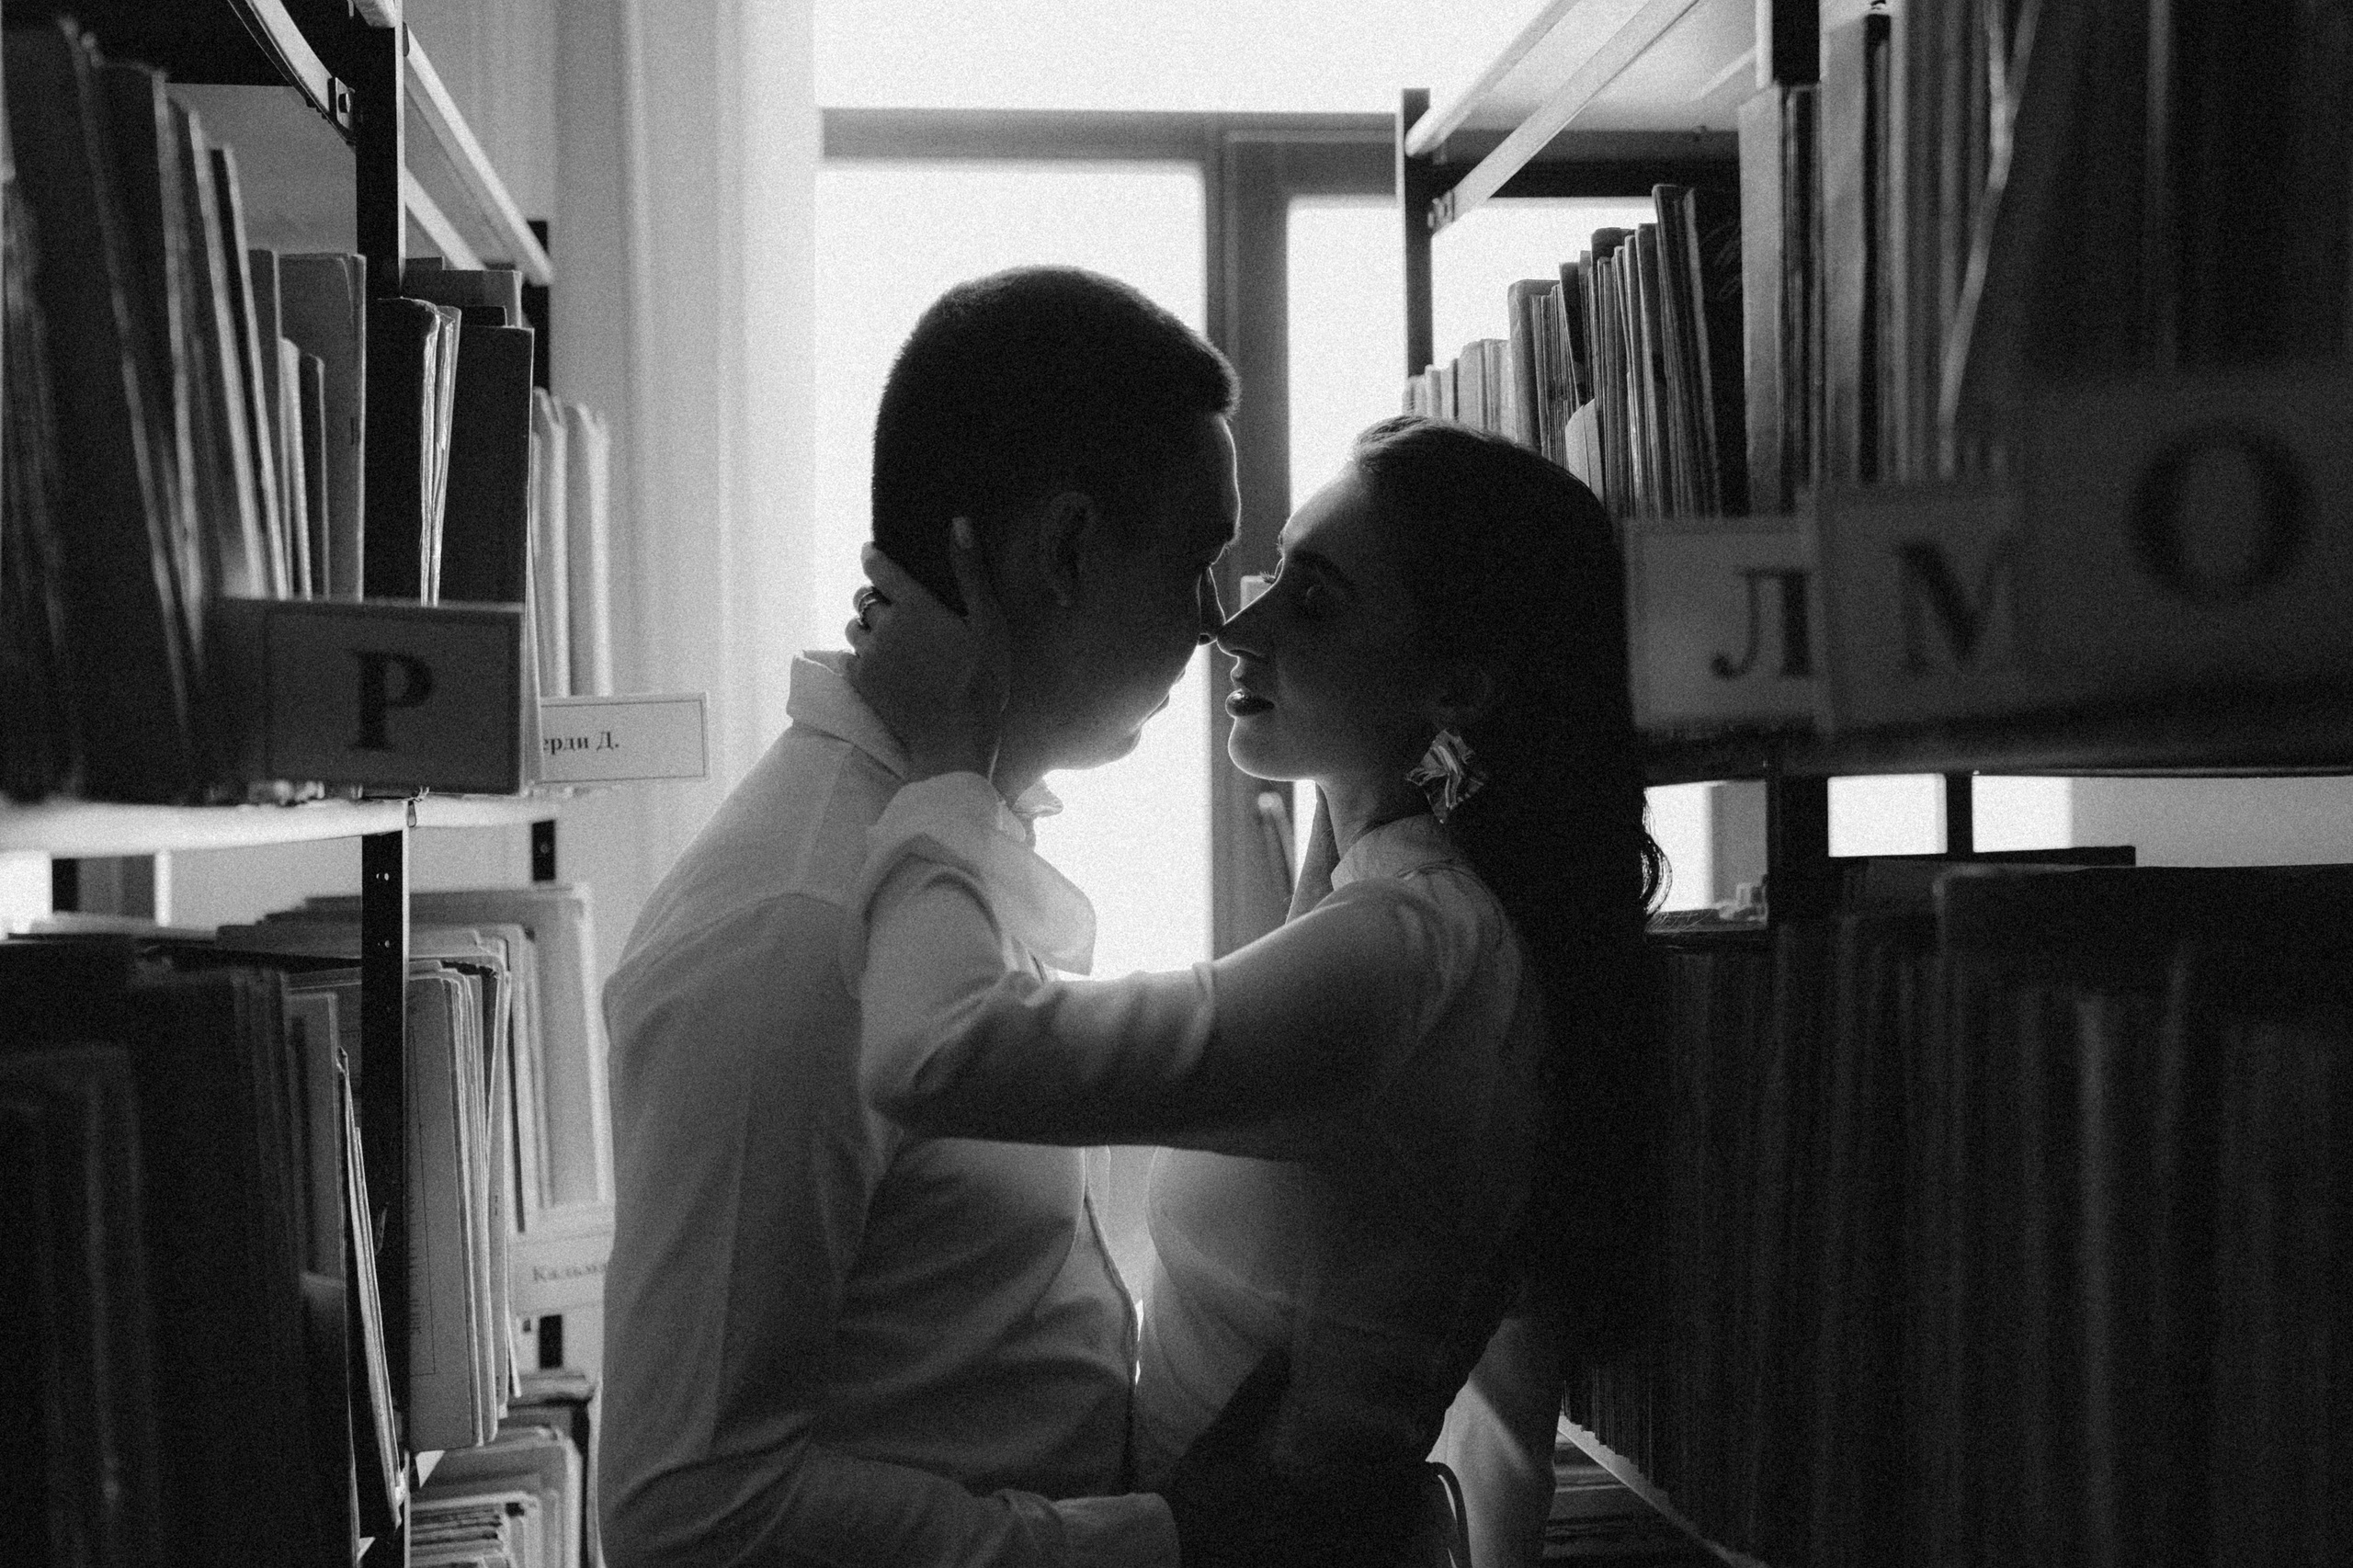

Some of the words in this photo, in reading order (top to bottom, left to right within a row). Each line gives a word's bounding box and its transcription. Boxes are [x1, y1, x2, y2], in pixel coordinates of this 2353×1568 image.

[2132, 418, 2314, 608] О
[1711, 567, 1812, 680] Л
[1895, 538, 2024, 676] М
[347, 648, 433, 753] Р
[596, 732, 620, 752] Д.
